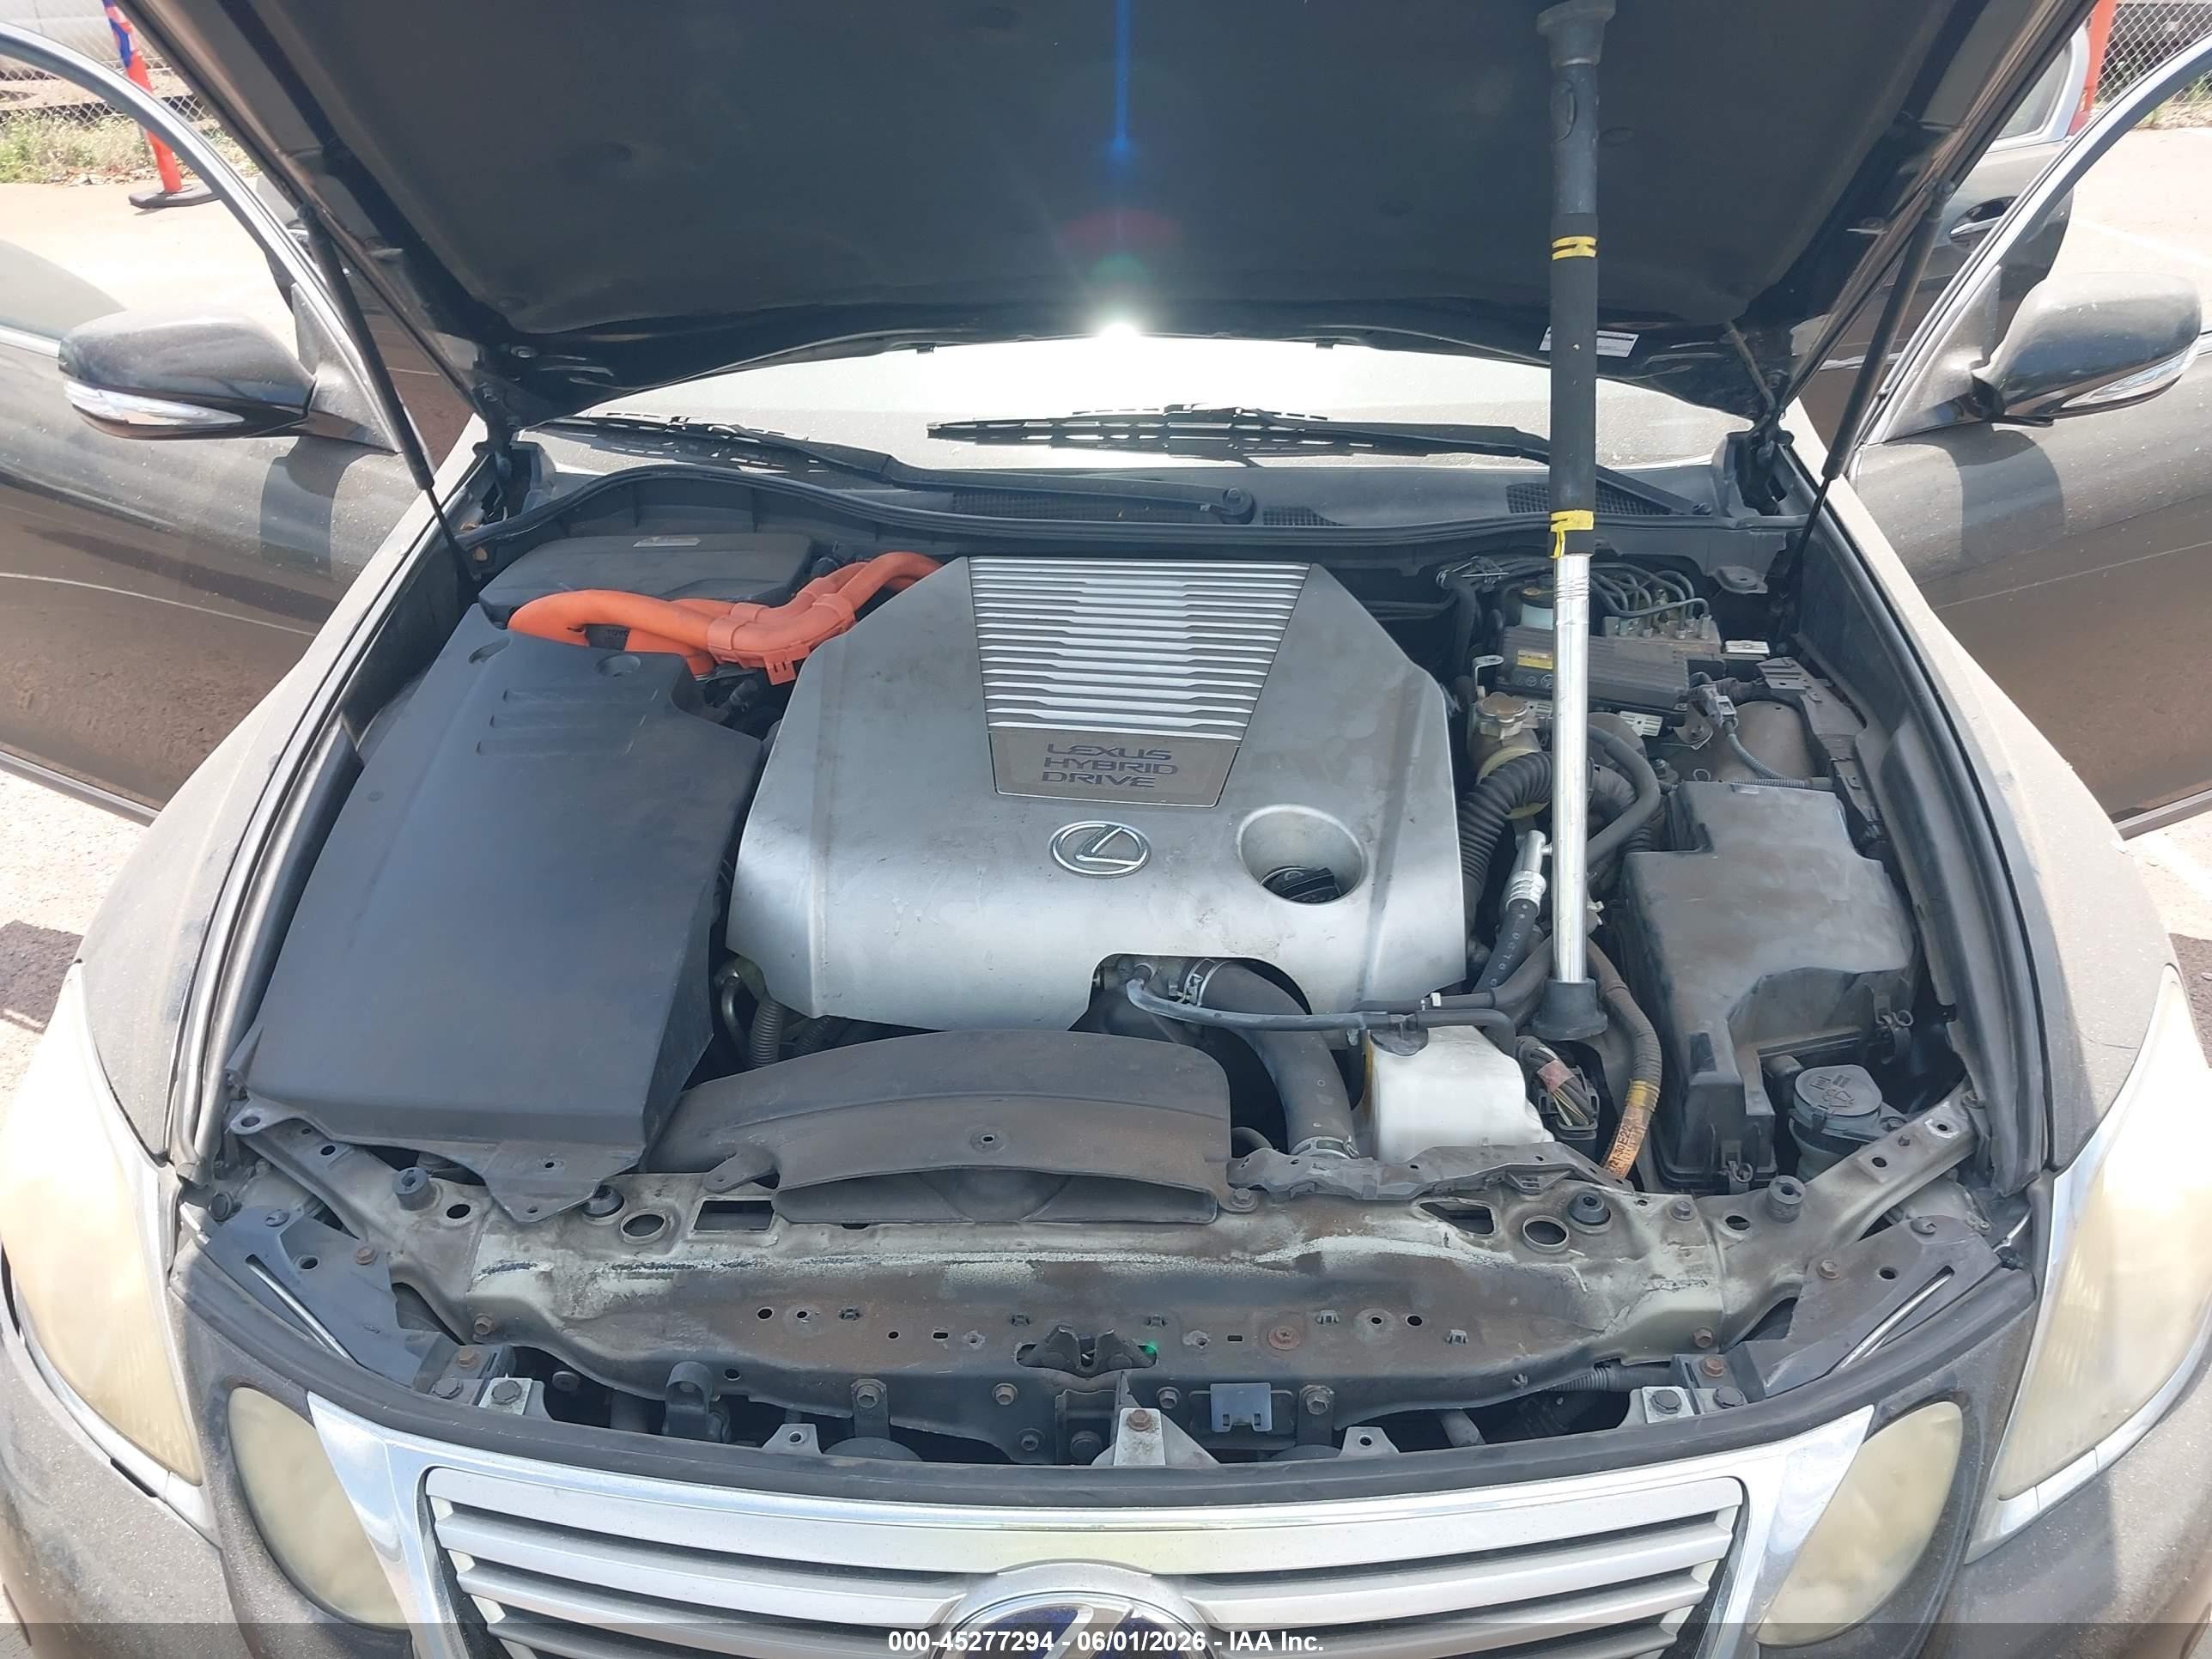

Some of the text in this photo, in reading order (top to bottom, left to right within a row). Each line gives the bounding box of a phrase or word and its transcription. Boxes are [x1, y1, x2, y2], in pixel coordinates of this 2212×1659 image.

[1047, 743, 1172, 761] LEXUS
[1043, 757, 1179, 775] HYBRID
[1042, 771, 1156, 788] DRIVE
